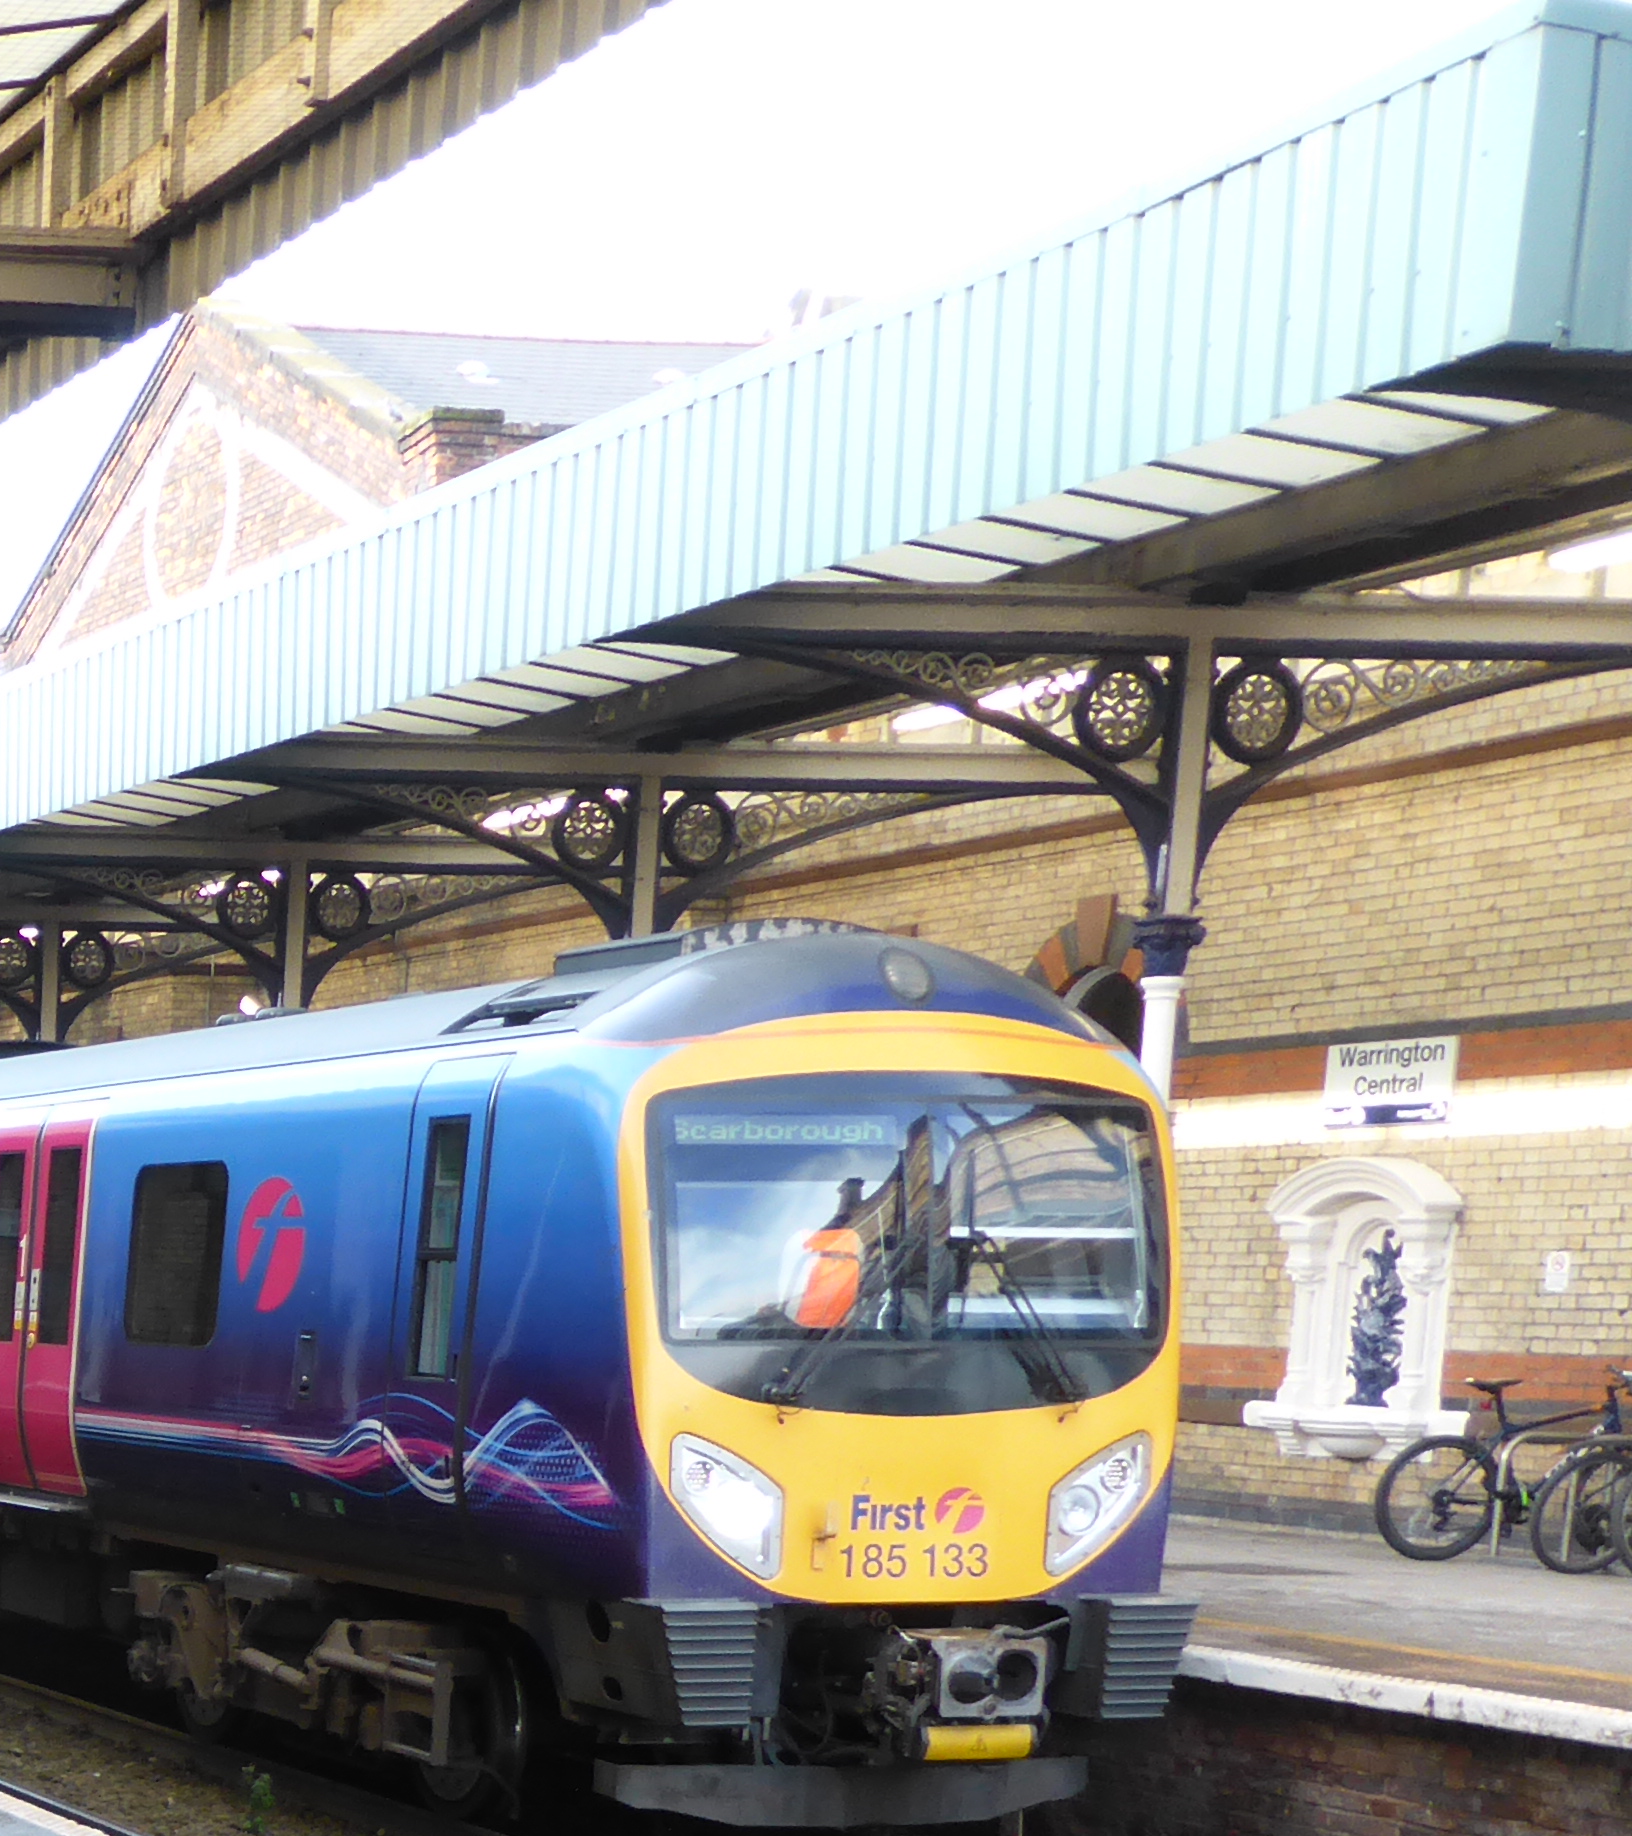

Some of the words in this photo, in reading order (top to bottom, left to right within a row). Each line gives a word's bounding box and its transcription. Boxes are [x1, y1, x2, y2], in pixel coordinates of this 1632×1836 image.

[1338, 1040, 1445, 1068] Warrington
[1353, 1072, 1424, 1096] Central
[675, 1120, 883, 1143] Scarborough
[850, 1494, 926, 1531] First
[840, 1543, 907, 1578] 185
[922, 1543, 988, 1578] 133
